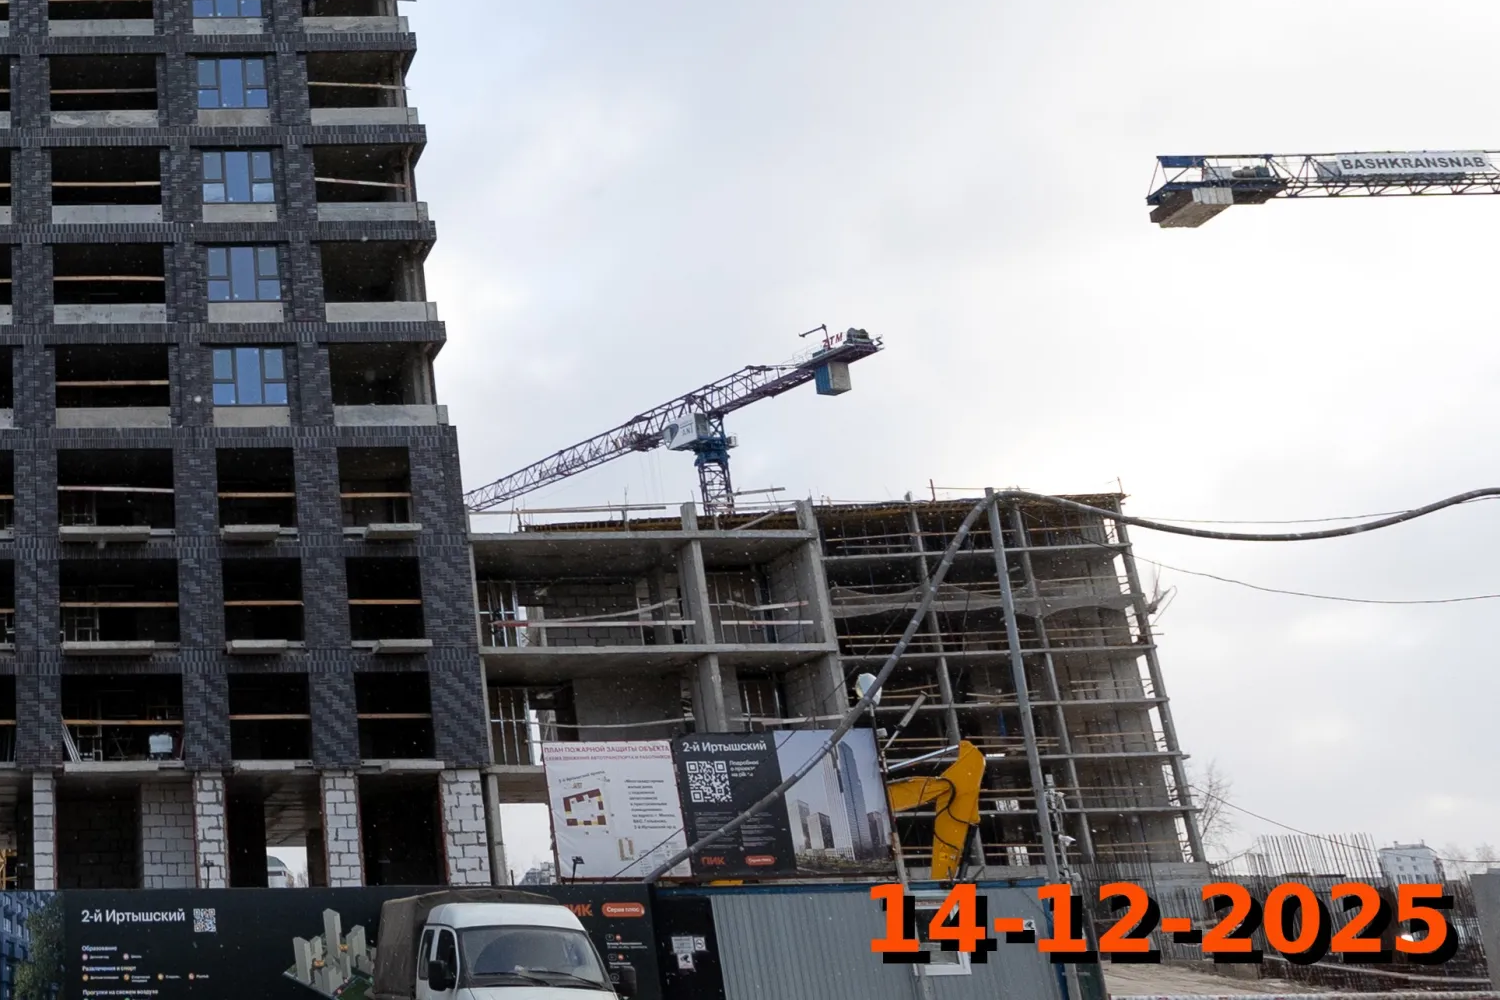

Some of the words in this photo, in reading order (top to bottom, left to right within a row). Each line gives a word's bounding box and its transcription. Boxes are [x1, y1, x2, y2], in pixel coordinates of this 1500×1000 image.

[1341, 156, 1486, 170] BASHKRANSNAB
[565, 745, 605, 753] ПОЖАРНОЙ
[682, 741, 700, 752] 2-й
[702, 740, 767, 753] Иртышский
[701, 857, 725, 865] ПИК
[81, 909, 102, 923] 2-й
[105, 908, 186, 925] Иртышский
[564, 904, 593, 917] ИК
[606, 906, 624, 914] Серия
